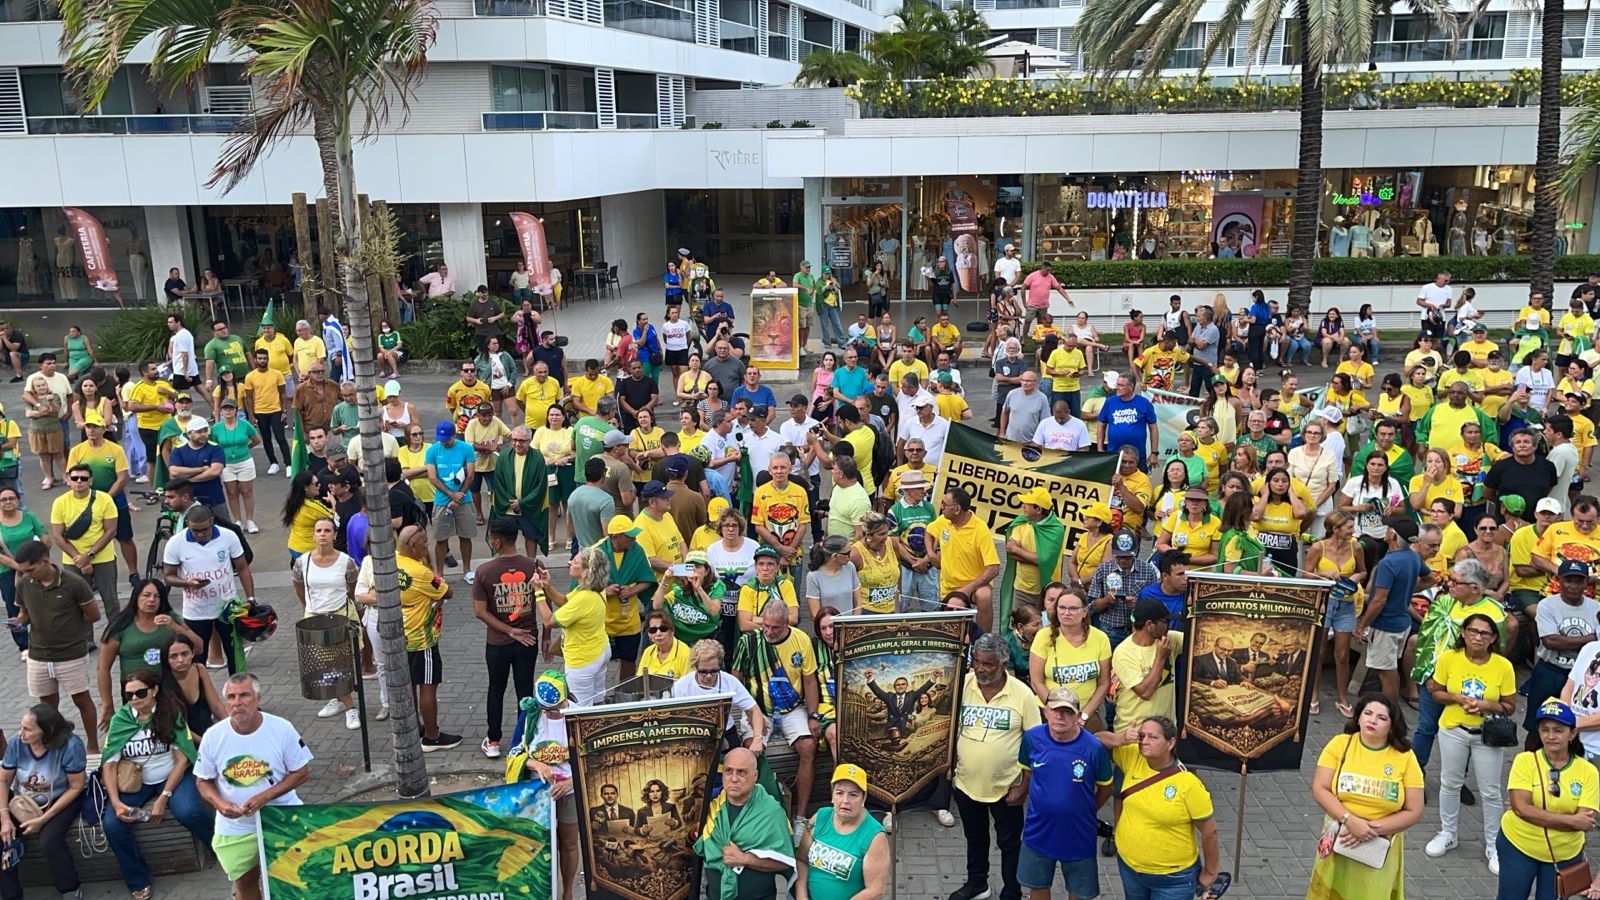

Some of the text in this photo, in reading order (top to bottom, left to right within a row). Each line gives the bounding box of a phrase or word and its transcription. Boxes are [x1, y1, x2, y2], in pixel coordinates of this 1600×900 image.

[709, 149, 760, 170] RIVIÈRE
[1086, 191, 1167, 209] DONATELLA
[77, 226, 97, 270] CAFETERIA
[1112, 407, 1138, 416] ACORDA
[1113, 414, 1138, 425] BRASIL
[948, 459, 1100, 502] LIBERDADE PARA
[493, 582, 533, 597] AMADO
[1205, 601, 1315, 617] CONTRATOS MILIONÁRIOS
[1559, 617, 1592, 634] PROUD
[844, 648, 853, 656] DA
[854, 644, 876, 655] ANISTIA
[877, 642, 900, 650] AMPLA,
[1055, 662, 1097, 677] ACORDA
[962, 705, 1009, 721] ACORDA
[643, 720, 659, 728] ALA
[593, 726, 711, 749] IMPRENSA AMESTRADA
[229, 759, 266, 770] ACORDA
[233, 768, 264, 779] BRASIL
[332, 831, 465, 875] ACORDA
[353, 862, 459, 900] Brasil
